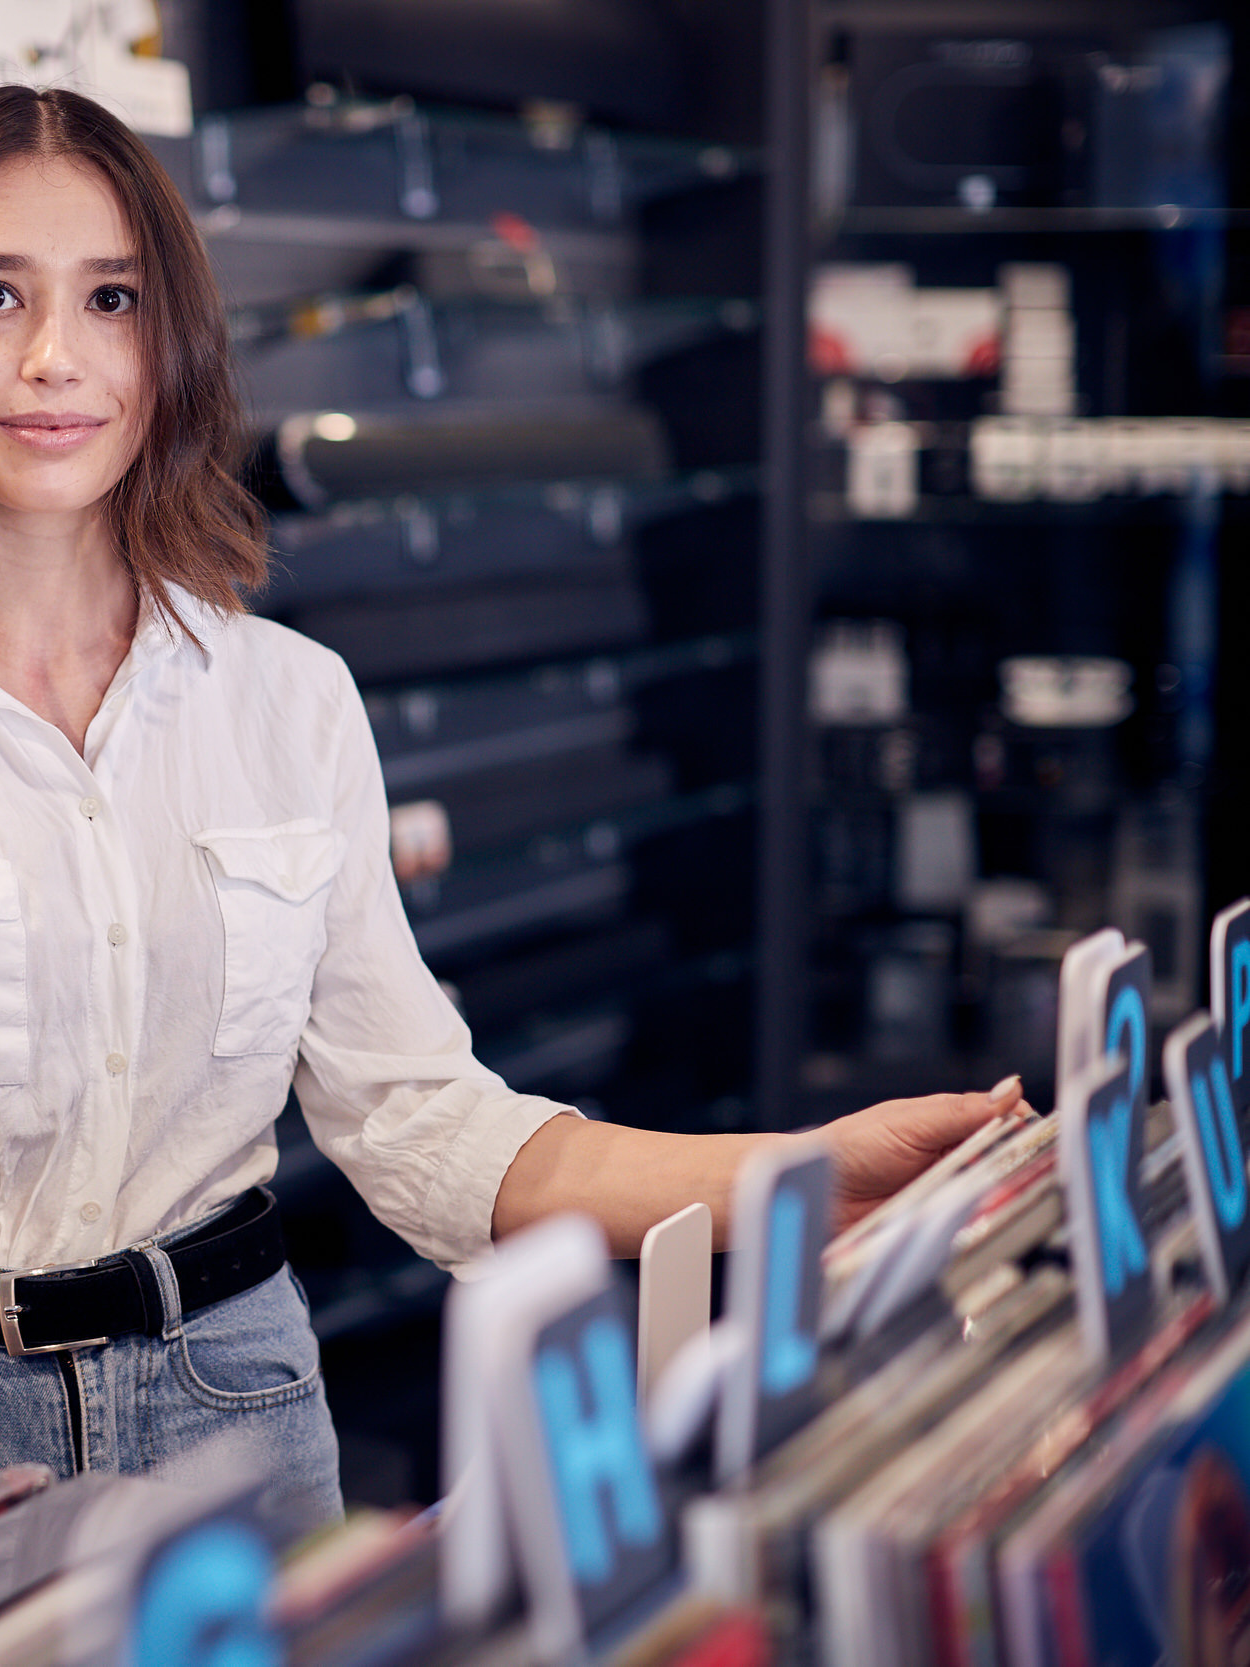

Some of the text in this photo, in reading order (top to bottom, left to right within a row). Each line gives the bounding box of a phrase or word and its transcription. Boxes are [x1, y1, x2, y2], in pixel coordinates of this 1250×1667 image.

[1087, 1101, 1147, 1294] K
[1191, 1056, 1246, 1230] U
[762, 1188, 819, 1394] L
[536, 1317, 660, 1582] H
